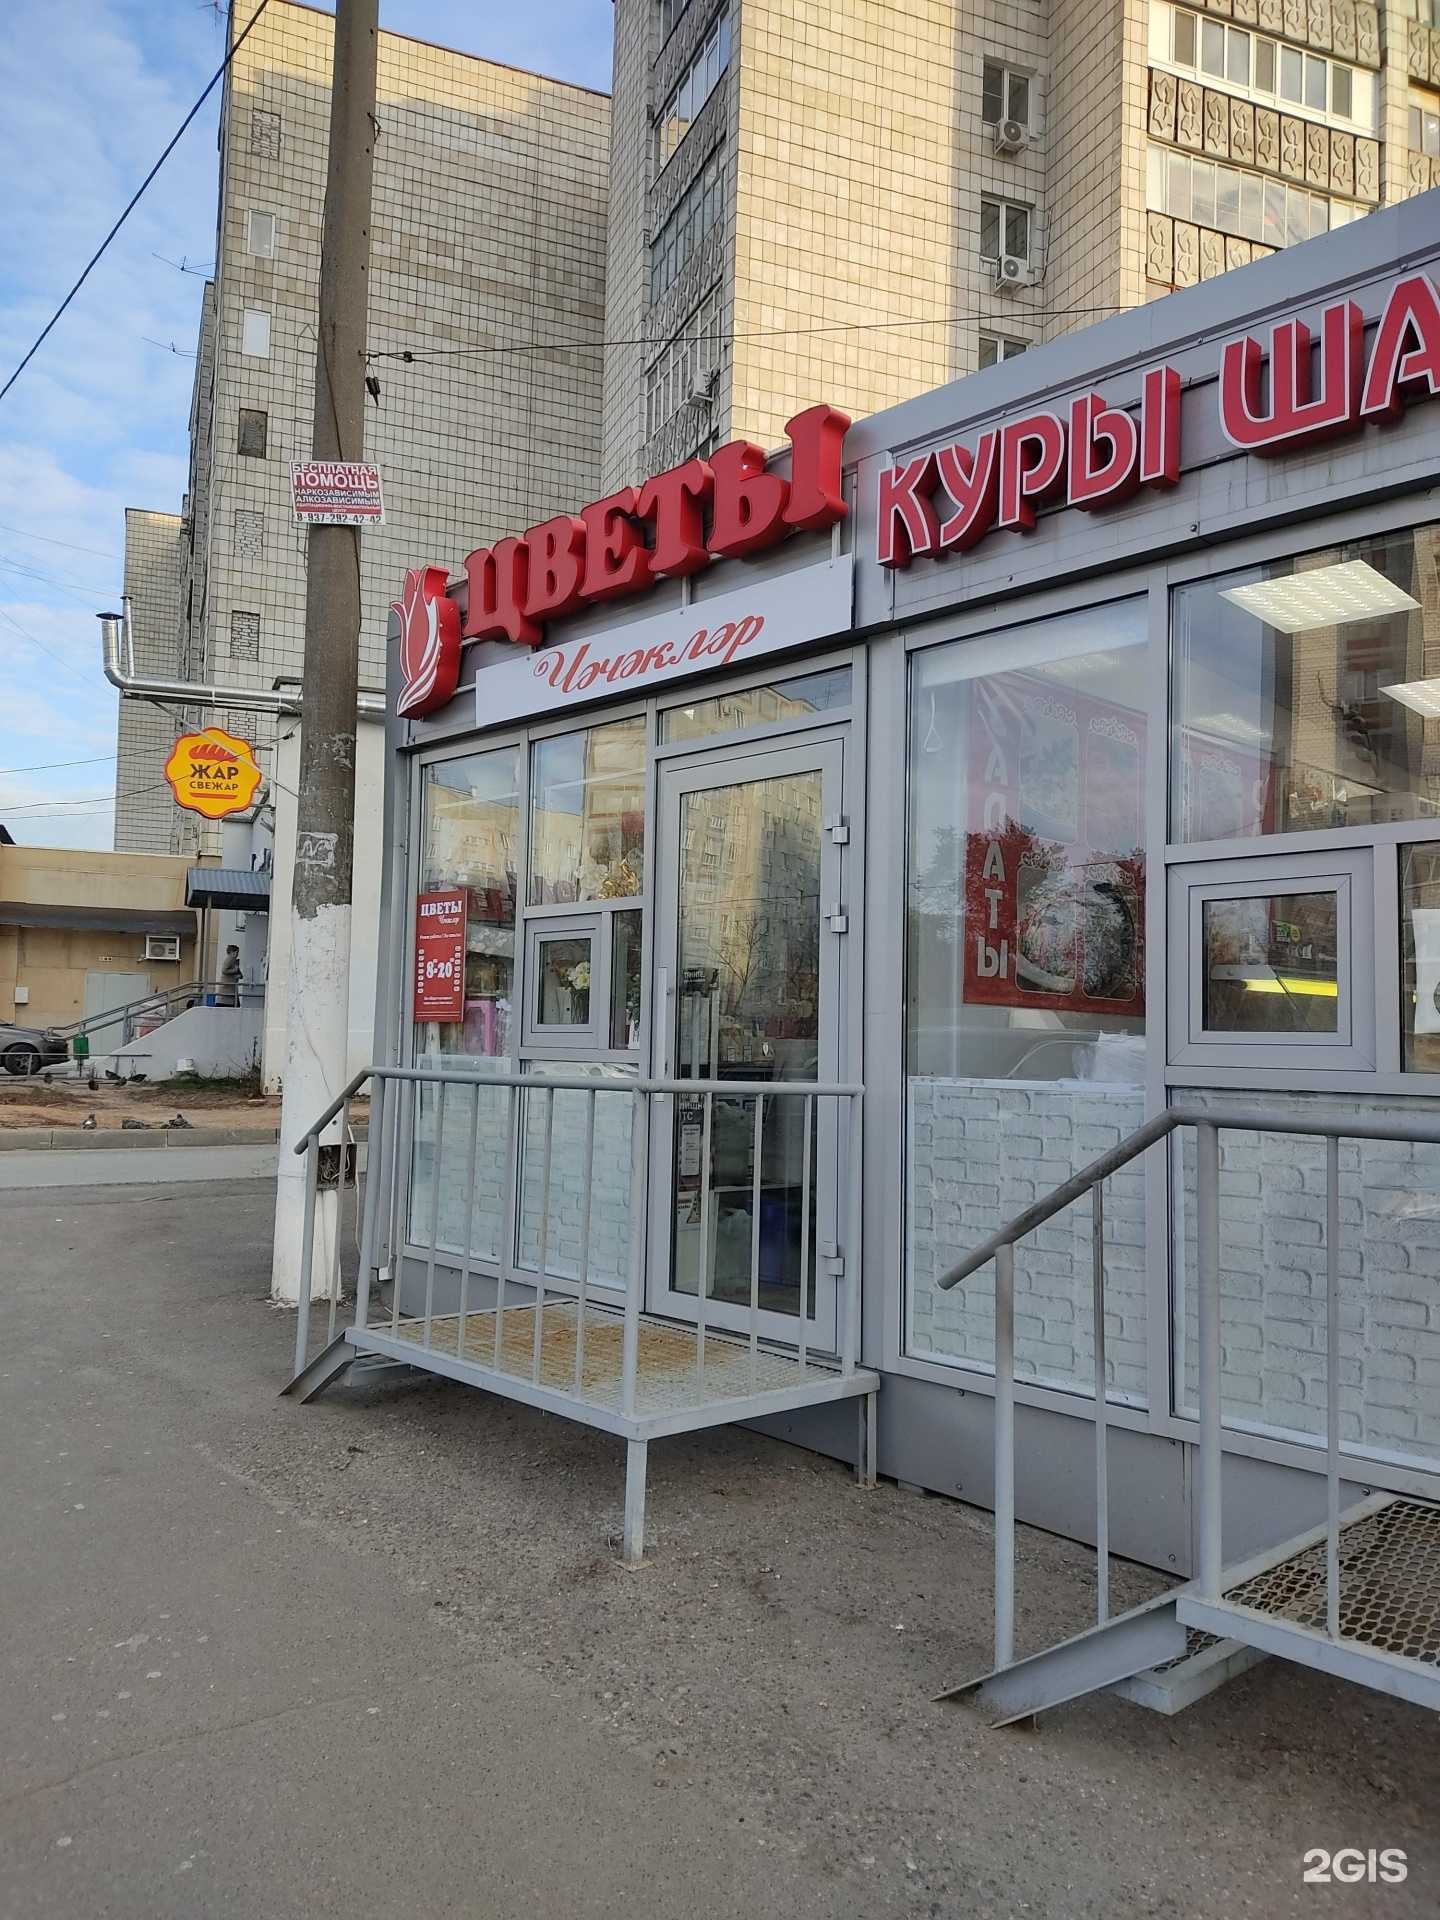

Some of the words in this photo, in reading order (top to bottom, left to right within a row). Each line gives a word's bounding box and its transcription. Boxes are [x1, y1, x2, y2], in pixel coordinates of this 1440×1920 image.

[292, 463, 377, 475] БЕСПЛАТНАЯ
[876, 364, 1181, 570] КУРЫ
[293, 473, 378, 490] ПОМОЩЬ
[294, 488, 379, 498] НАРКОЗАВИСИМЫМ
[295, 496, 380, 505] АЛКОЗАВИСИМЫМ
[463, 403, 852, 646] ЦВЕТЫ
[190, 764, 239, 780] ЖАР
[189, 781, 239, 791] СВЕЖАР
[420, 900, 462, 917] ЦВЕТЫ
